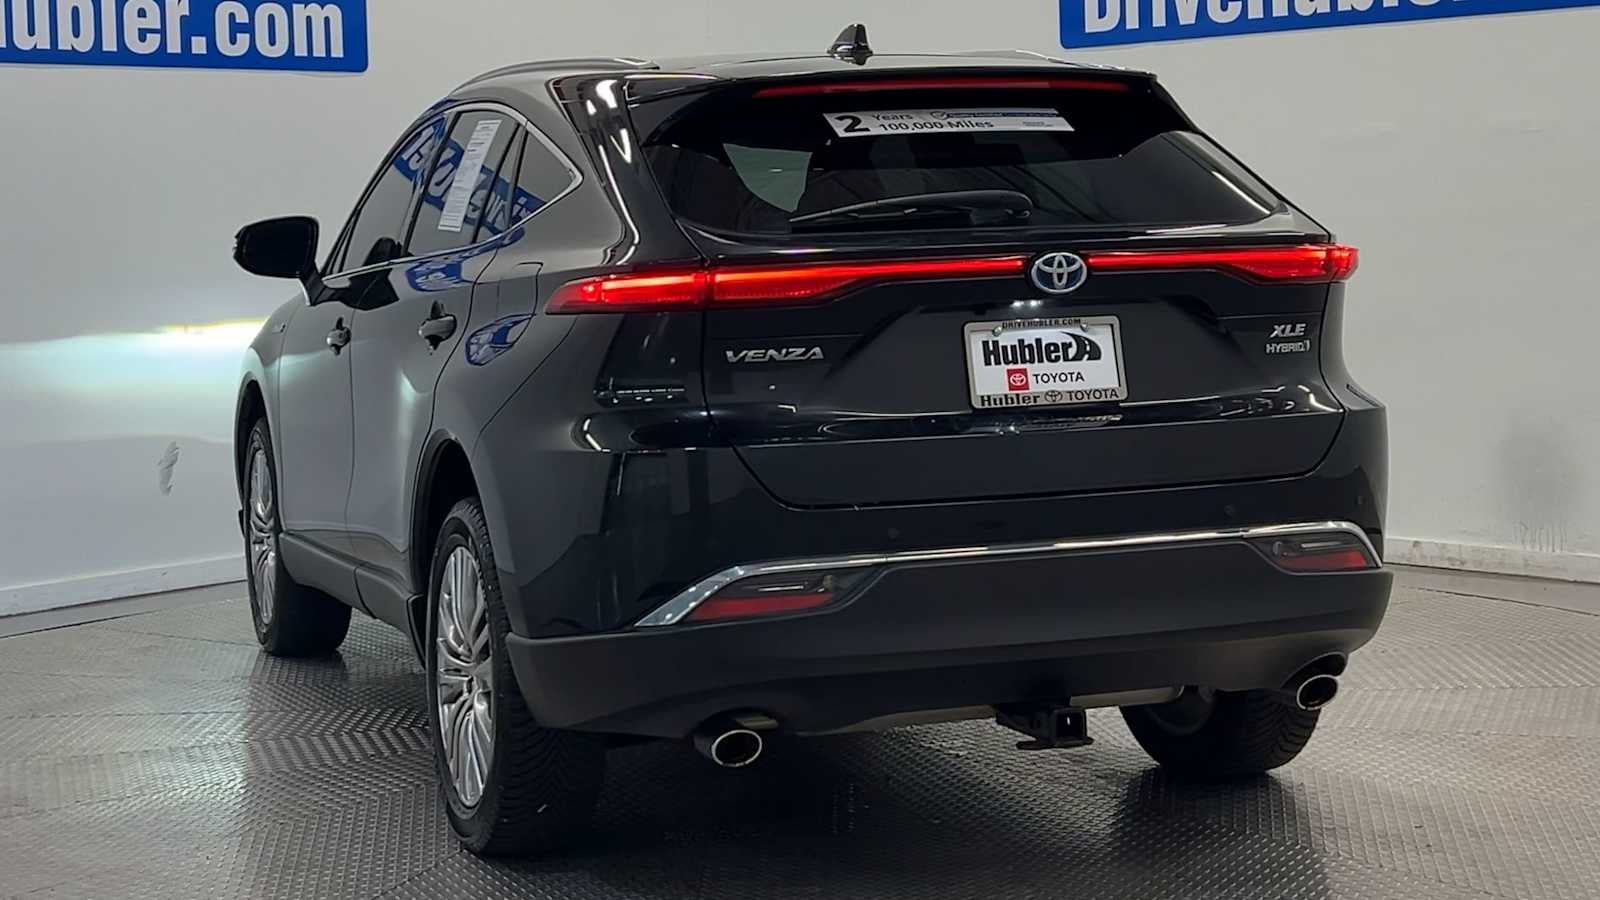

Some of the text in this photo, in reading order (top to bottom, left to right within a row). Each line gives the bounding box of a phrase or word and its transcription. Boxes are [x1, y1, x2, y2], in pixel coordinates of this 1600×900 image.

[0, 0, 345, 58] ubler.com
[835, 114, 913, 133] 2 Years
[947, 120, 994, 128] Miles
[1002, 317, 1081, 329] DRIVEHUBLER.COM
[1270, 323, 1306, 338] XLE
[726, 347, 824, 362] VENZA
[982, 338, 1073, 366] Hubler
[1266, 342, 1305, 353] HYBRID
[1032, 371, 1085, 384] TOYOTA
[980, 388, 1120, 407] Hubler TOYOTA
